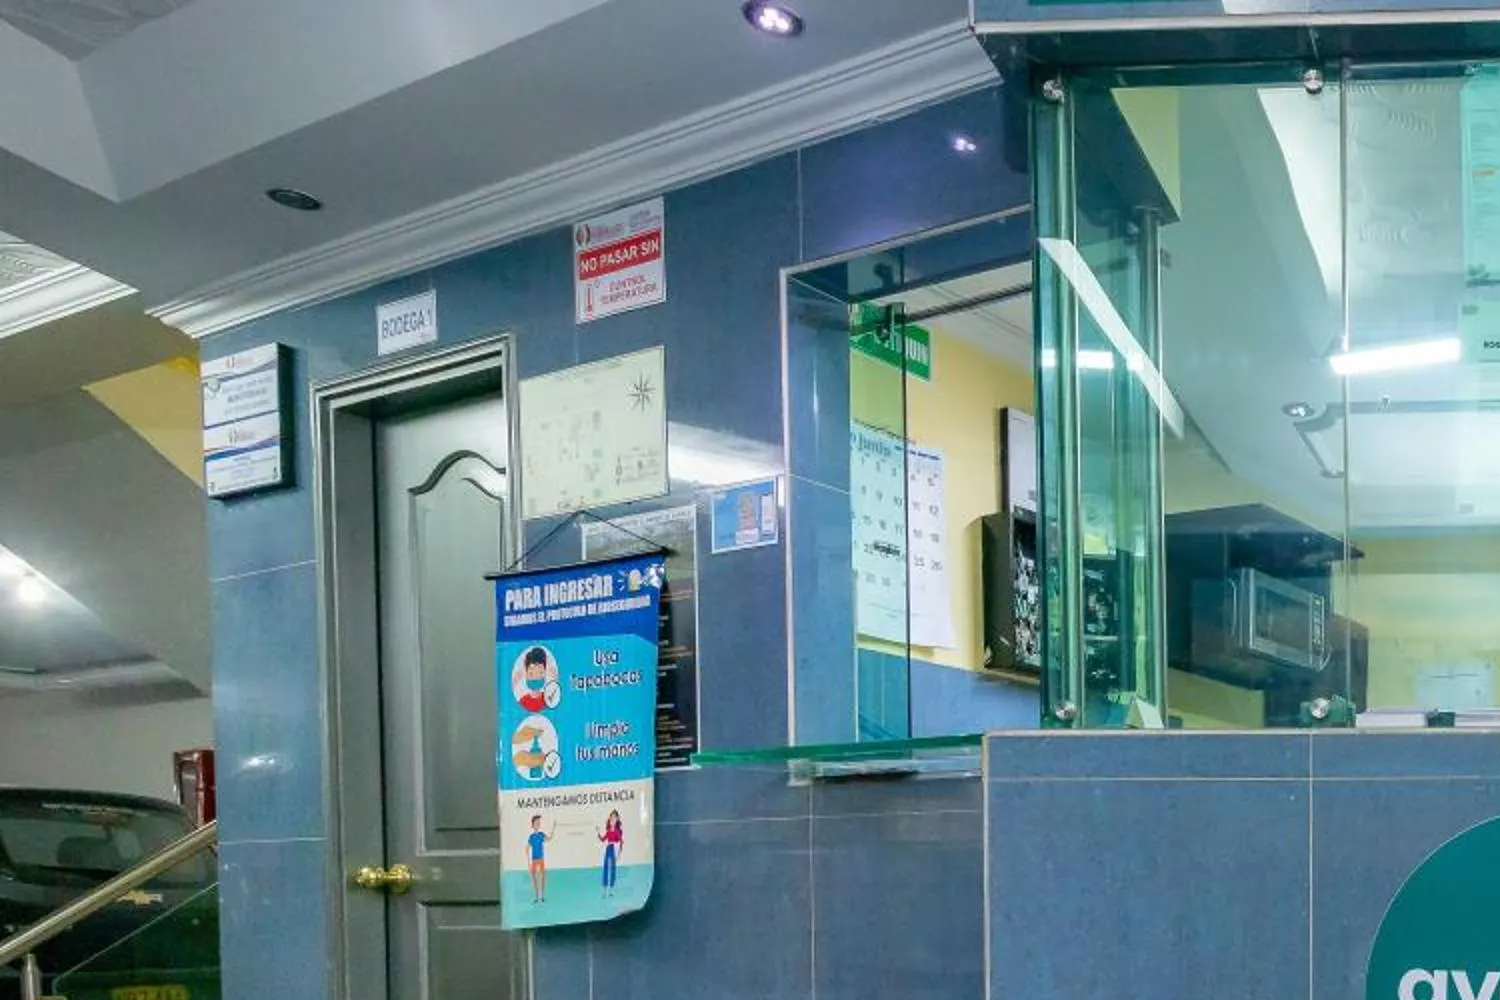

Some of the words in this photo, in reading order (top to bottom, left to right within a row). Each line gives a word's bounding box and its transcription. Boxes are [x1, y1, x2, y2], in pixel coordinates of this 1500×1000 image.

[581, 257, 598, 273] NO
[600, 245, 638, 270] PASAR
[641, 238, 659, 257] SIN
[382, 309, 425, 339] BODEGA
[505, 585, 542, 611] PARA
[543, 574, 613, 606] INGRESAR
